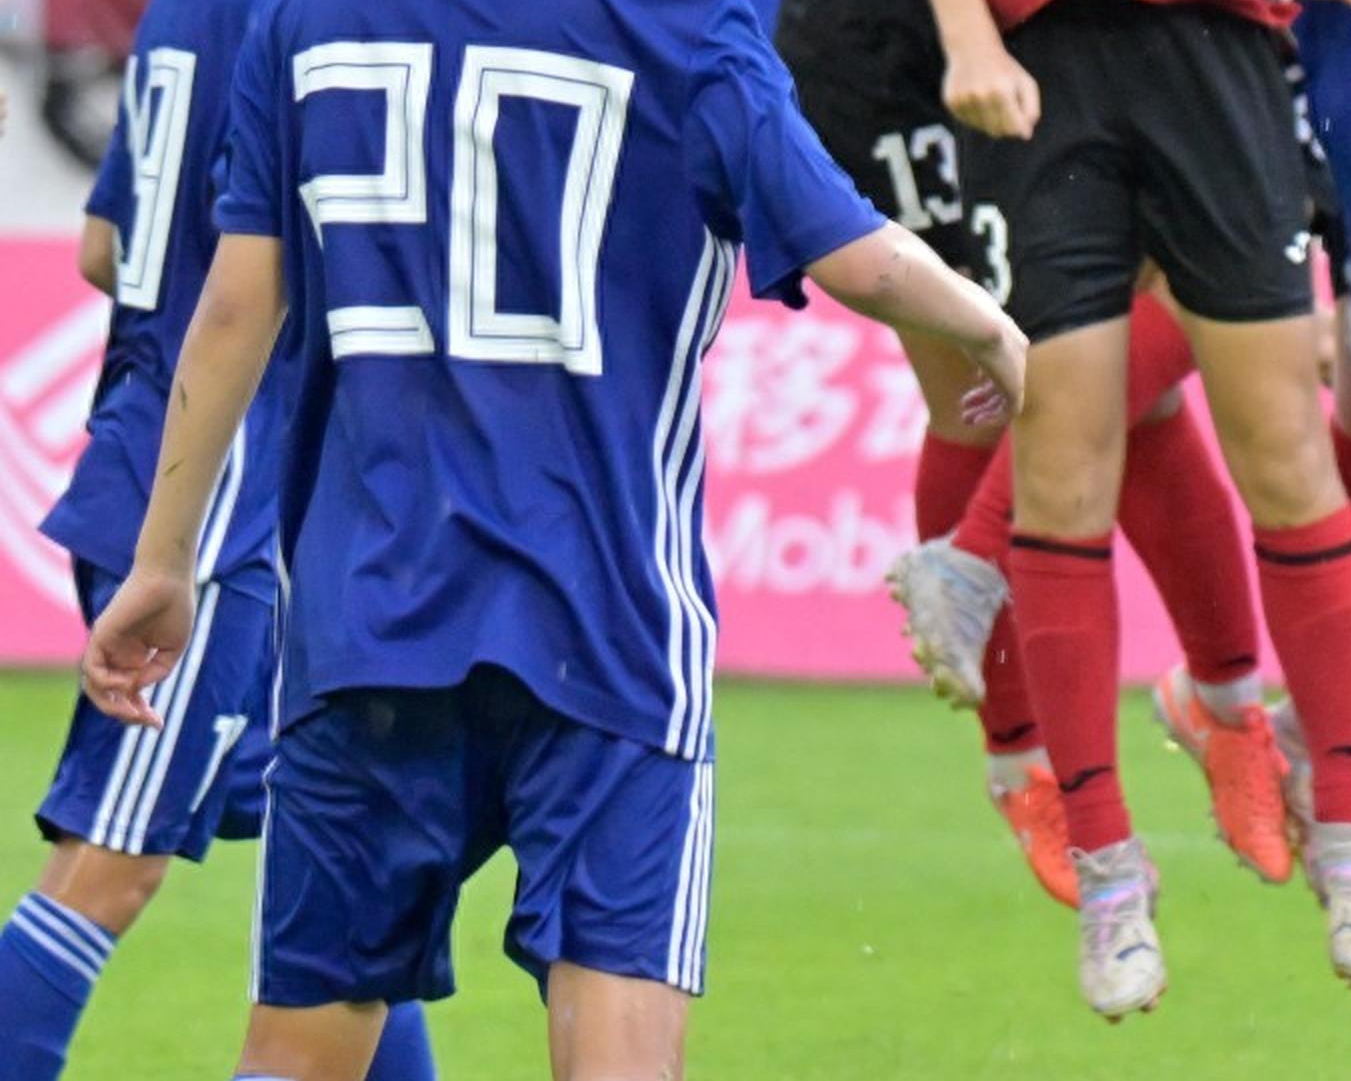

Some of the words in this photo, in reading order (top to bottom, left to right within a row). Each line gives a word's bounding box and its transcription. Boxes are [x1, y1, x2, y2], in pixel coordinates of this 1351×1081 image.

[293, 42, 635, 376] 20
[872, 124, 964, 232] 13
[972, 204, 1012, 306] 3
